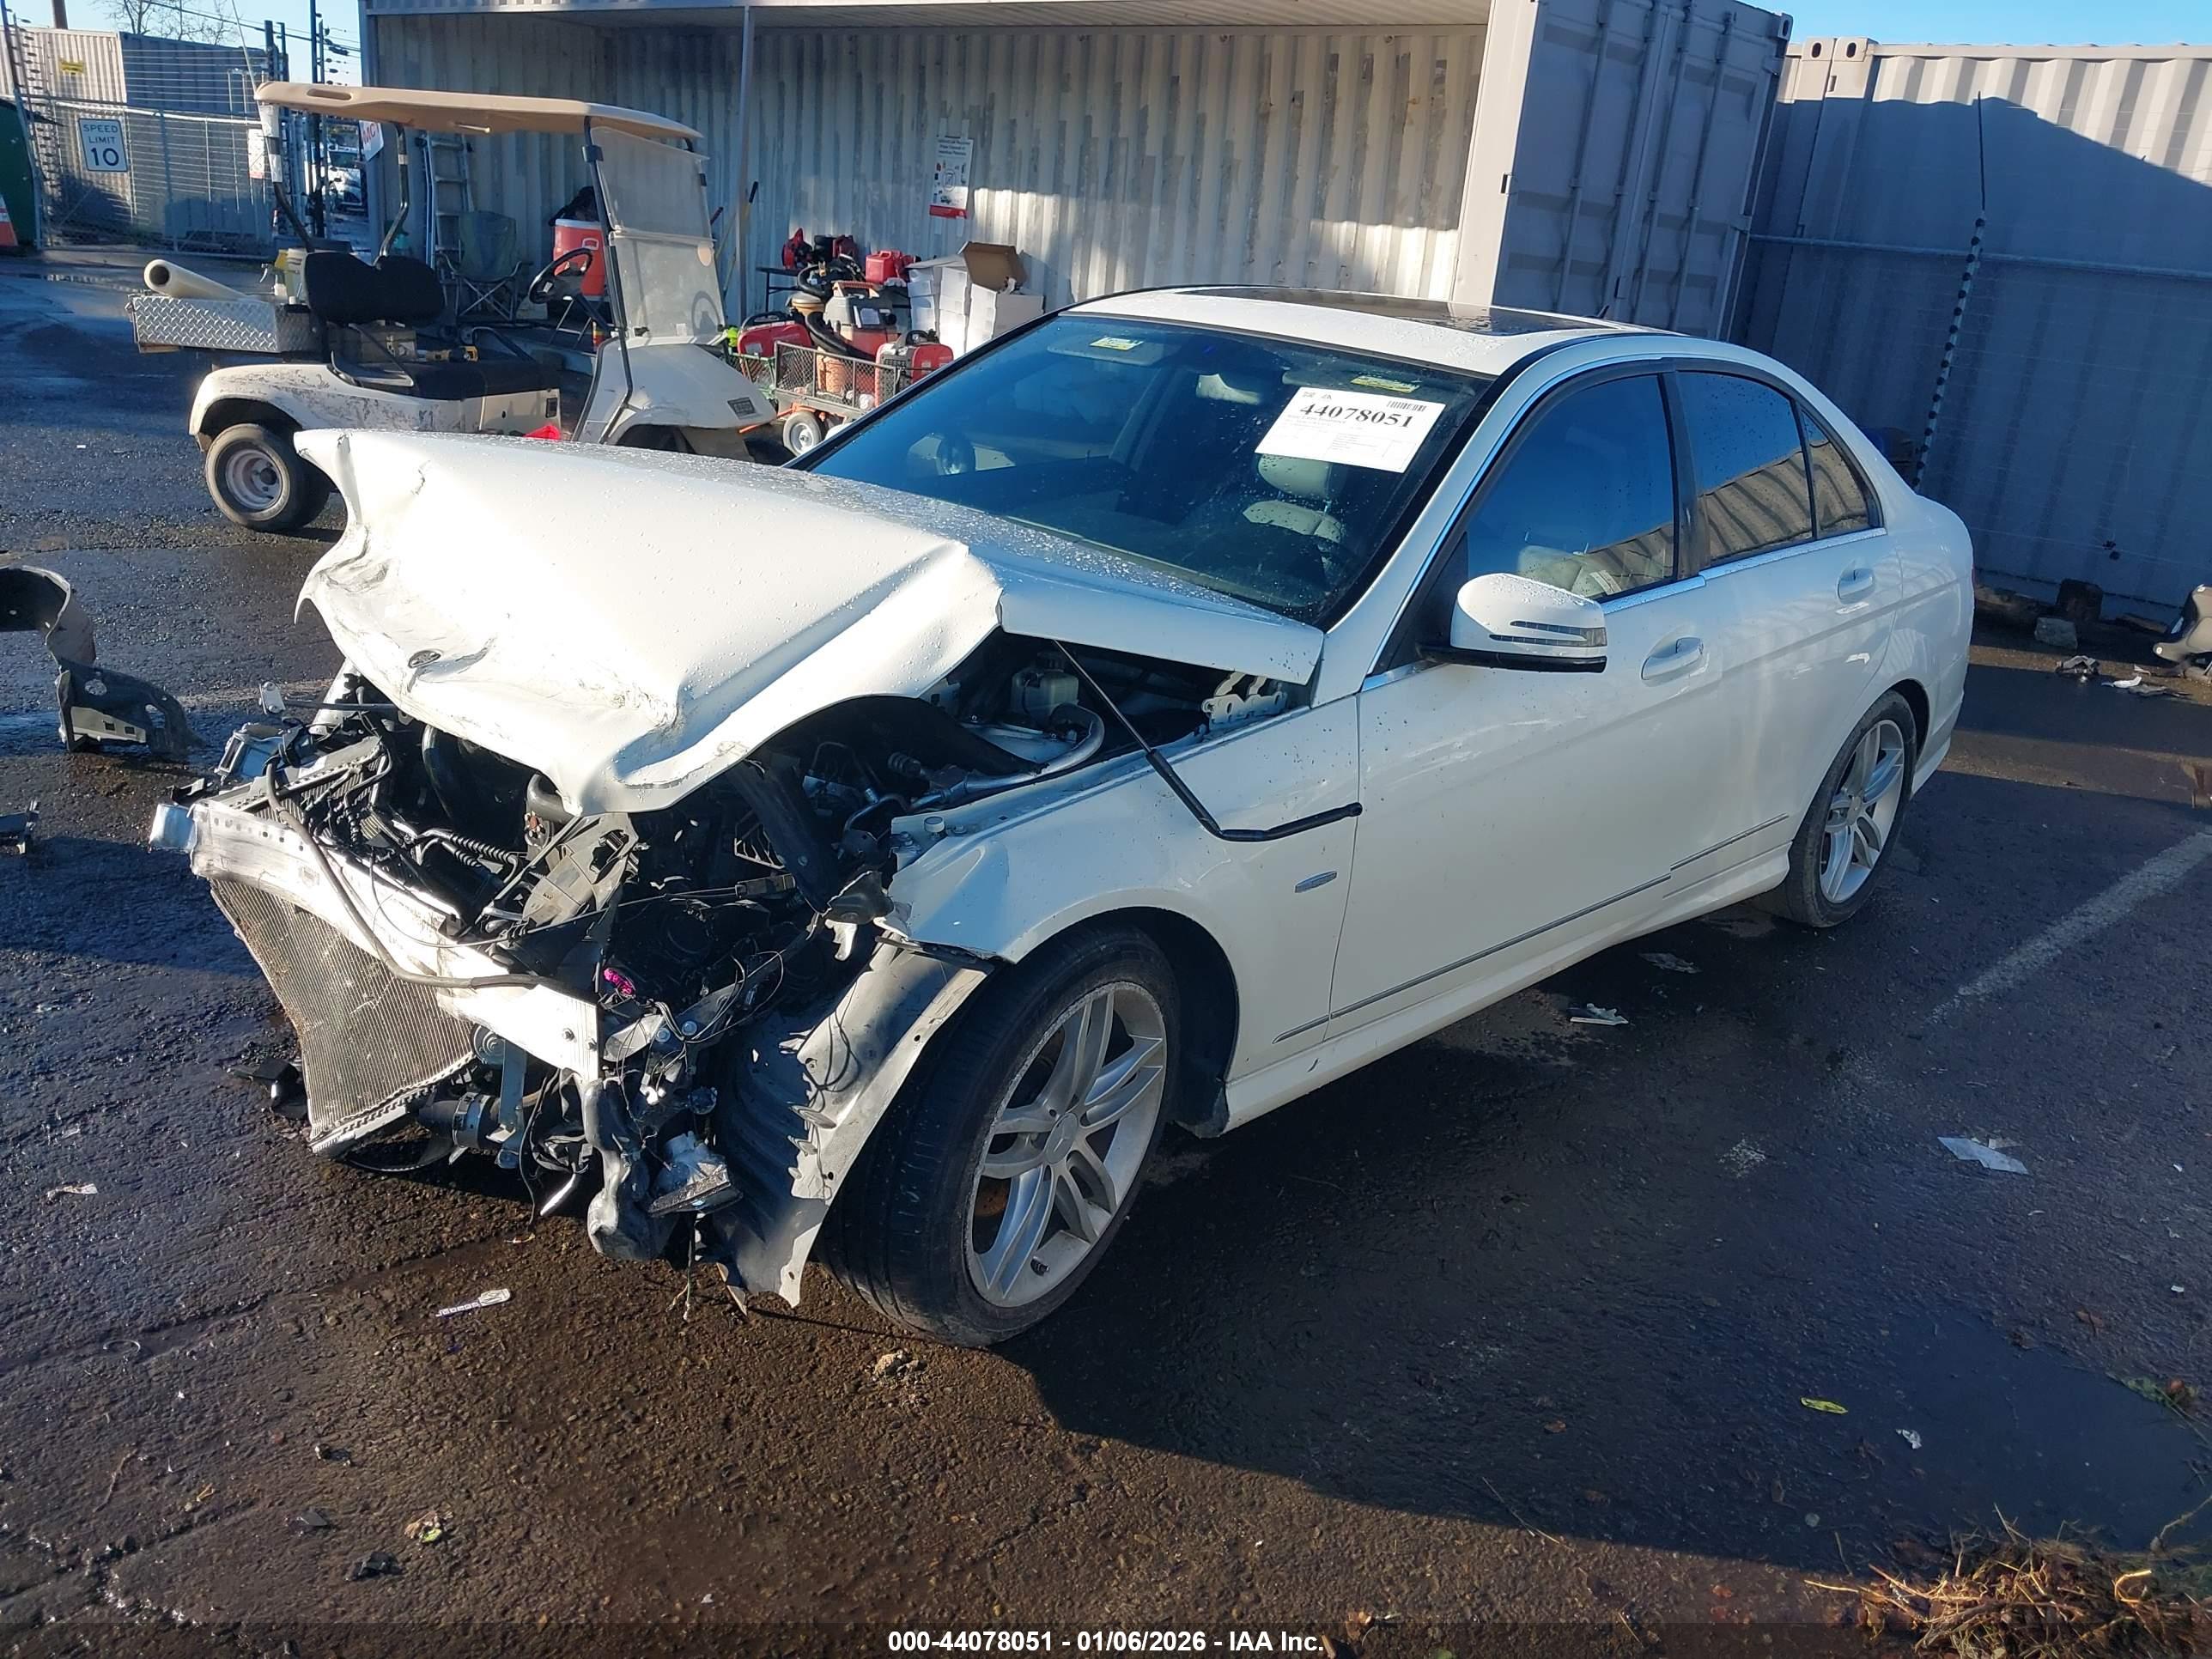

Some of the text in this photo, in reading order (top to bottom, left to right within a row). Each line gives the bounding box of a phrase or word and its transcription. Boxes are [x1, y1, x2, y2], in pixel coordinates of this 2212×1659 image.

[83, 124, 118, 133] SPEED
[88, 136, 116, 144] LIMIT
[90, 147, 119, 167] 10
[1299, 403, 1414, 428] 44078051
